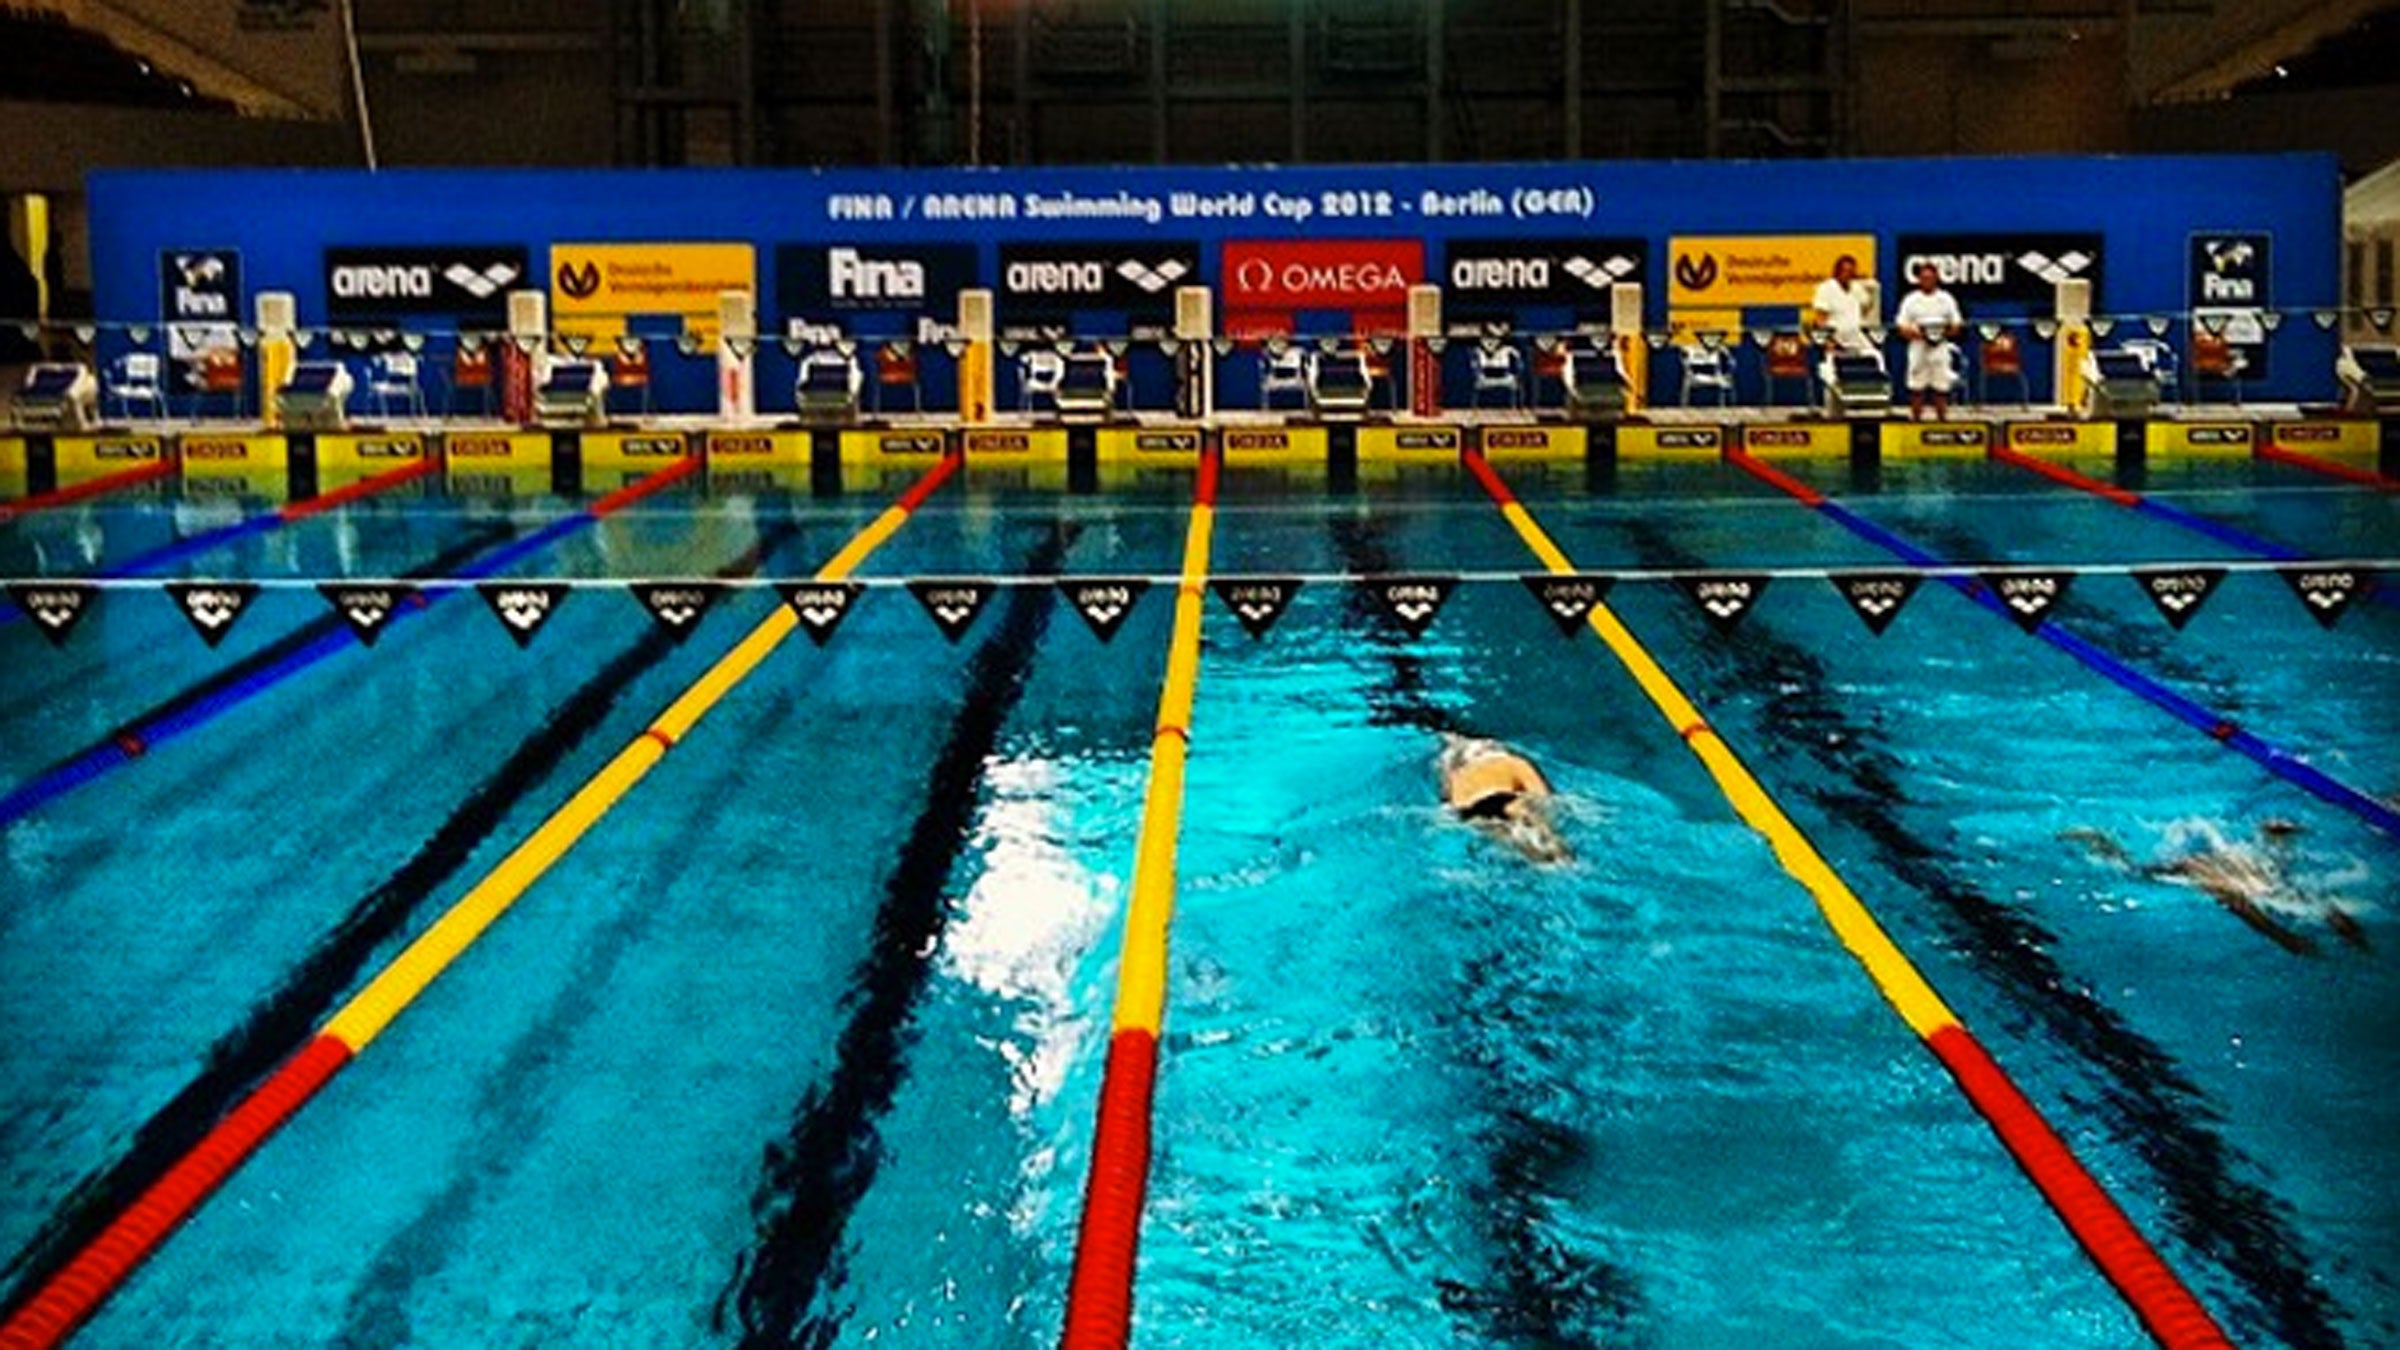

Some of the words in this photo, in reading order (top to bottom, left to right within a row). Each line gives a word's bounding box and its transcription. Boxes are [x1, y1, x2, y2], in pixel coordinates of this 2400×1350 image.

[828, 194, 894, 219] FINA
[922, 194, 1017, 219] ARENA
[1024, 191, 1162, 224] Swimming
[1169, 192, 1255, 217] World
[1262, 192, 1313, 222] Cup
[1321, 191, 1392, 217] 2012
[1420, 189, 1503, 216] Berlin
[1510, 186, 1595, 218] (GER)
[332, 266, 432, 297] arena
[1006, 261, 1103, 292] arena
[1282, 264, 1405, 290] OMEGA
[1451, 258, 1549, 289] arena
[1904, 254, 2004, 284] aena
